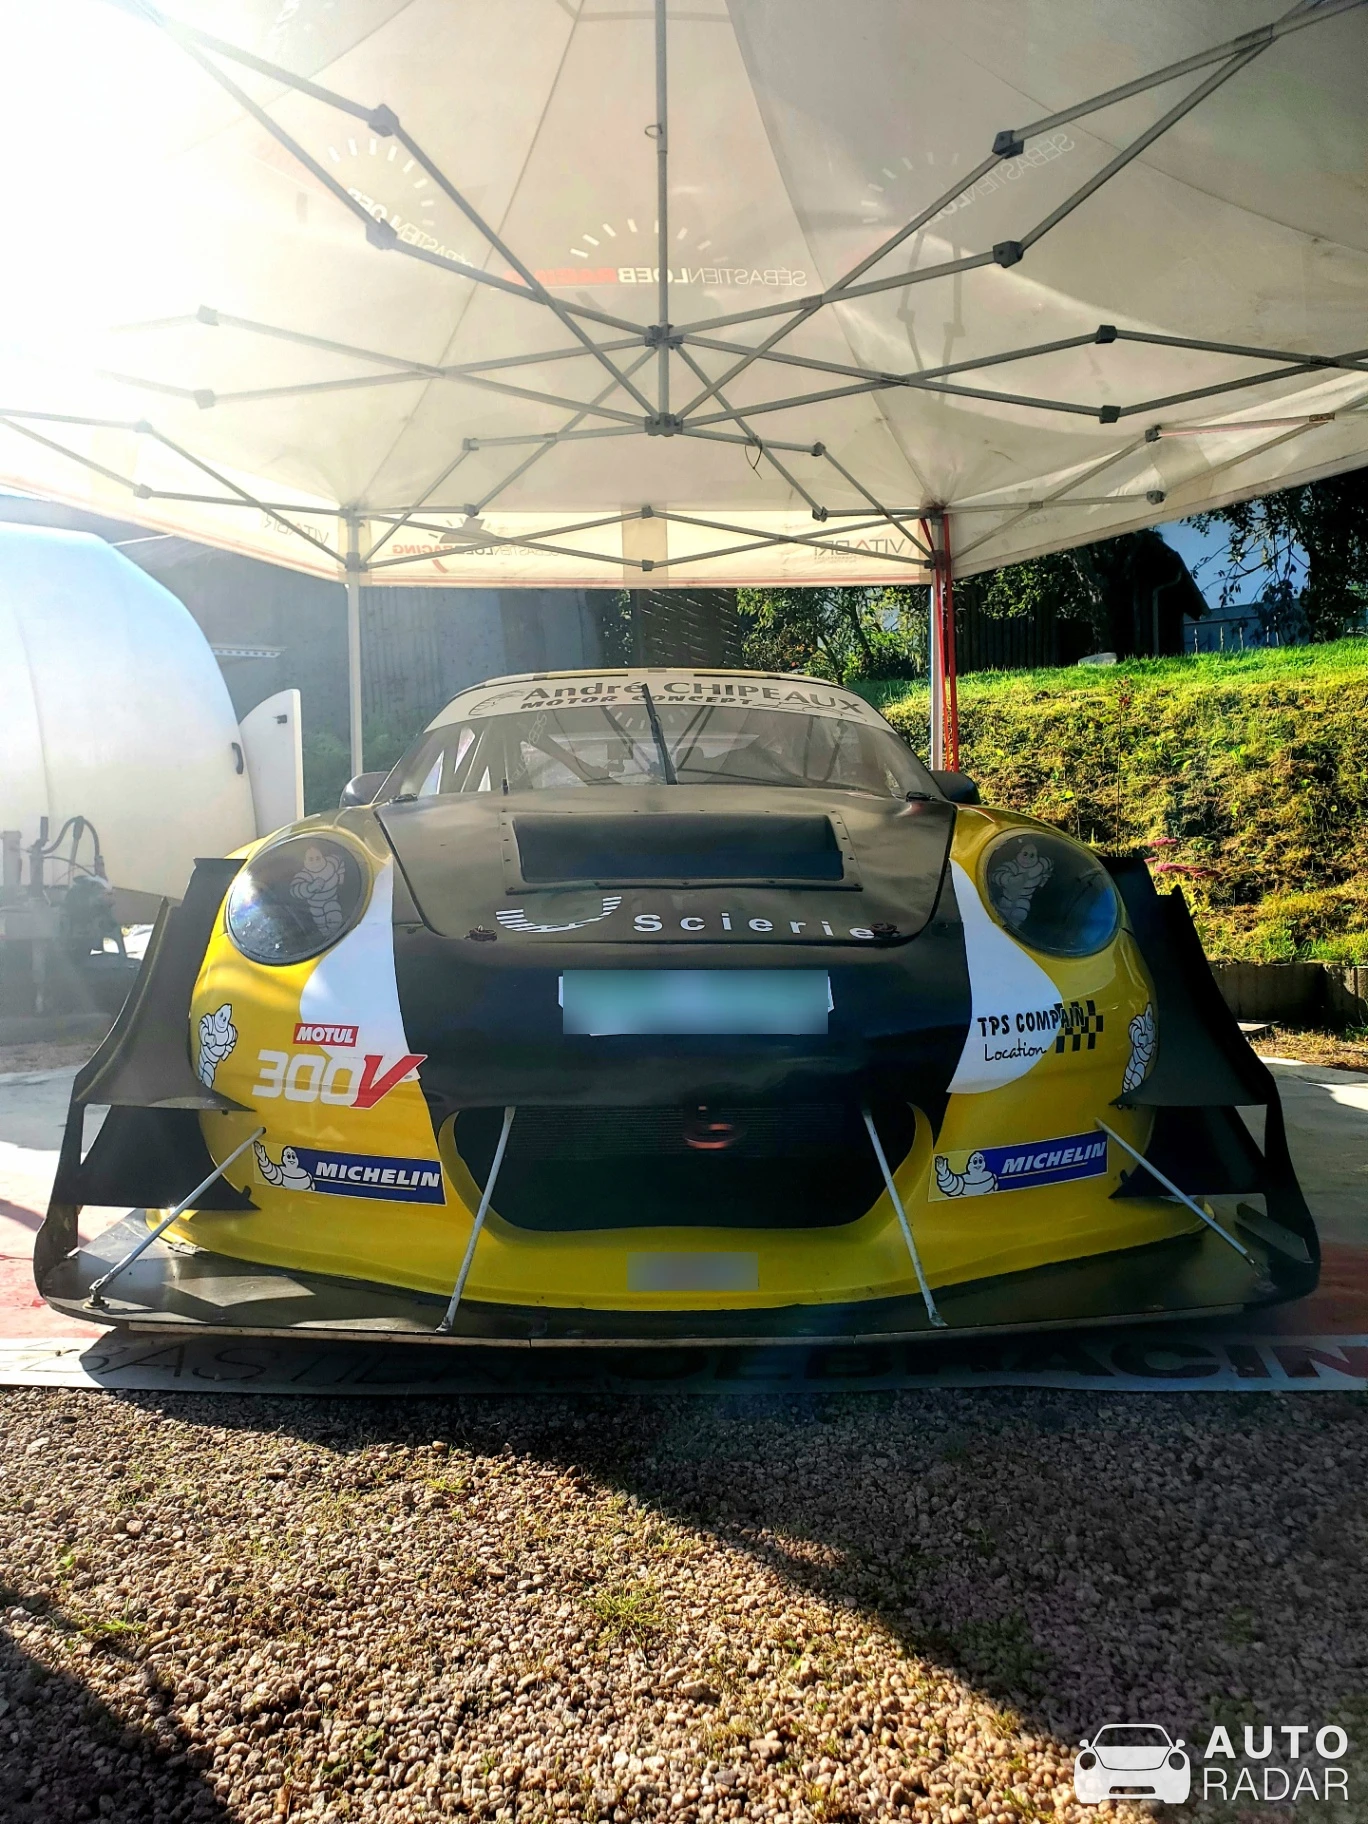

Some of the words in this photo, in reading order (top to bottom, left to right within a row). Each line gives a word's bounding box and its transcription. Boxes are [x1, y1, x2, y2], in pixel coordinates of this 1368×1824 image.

[520, 695, 618, 710] MOTOR
[631, 694, 753, 705] CONCEPT
[523, 681, 643, 701] André
[663, 682, 864, 714] CHIPEAUX
[633, 911, 876, 940] Scierie
[296, 1026, 354, 1043] MOTUL
[977, 1014, 1010, 1037] TPS
[1016, 1006, 1085, 1034] COMPAIN
[984, 1038, 1048, 1062] Location
[251, 1049, 428, 1110] 300V
[1001, 1141, 1106, 1174] MICHELIN
[315, 1161, 440, 1188] MICHELIN
